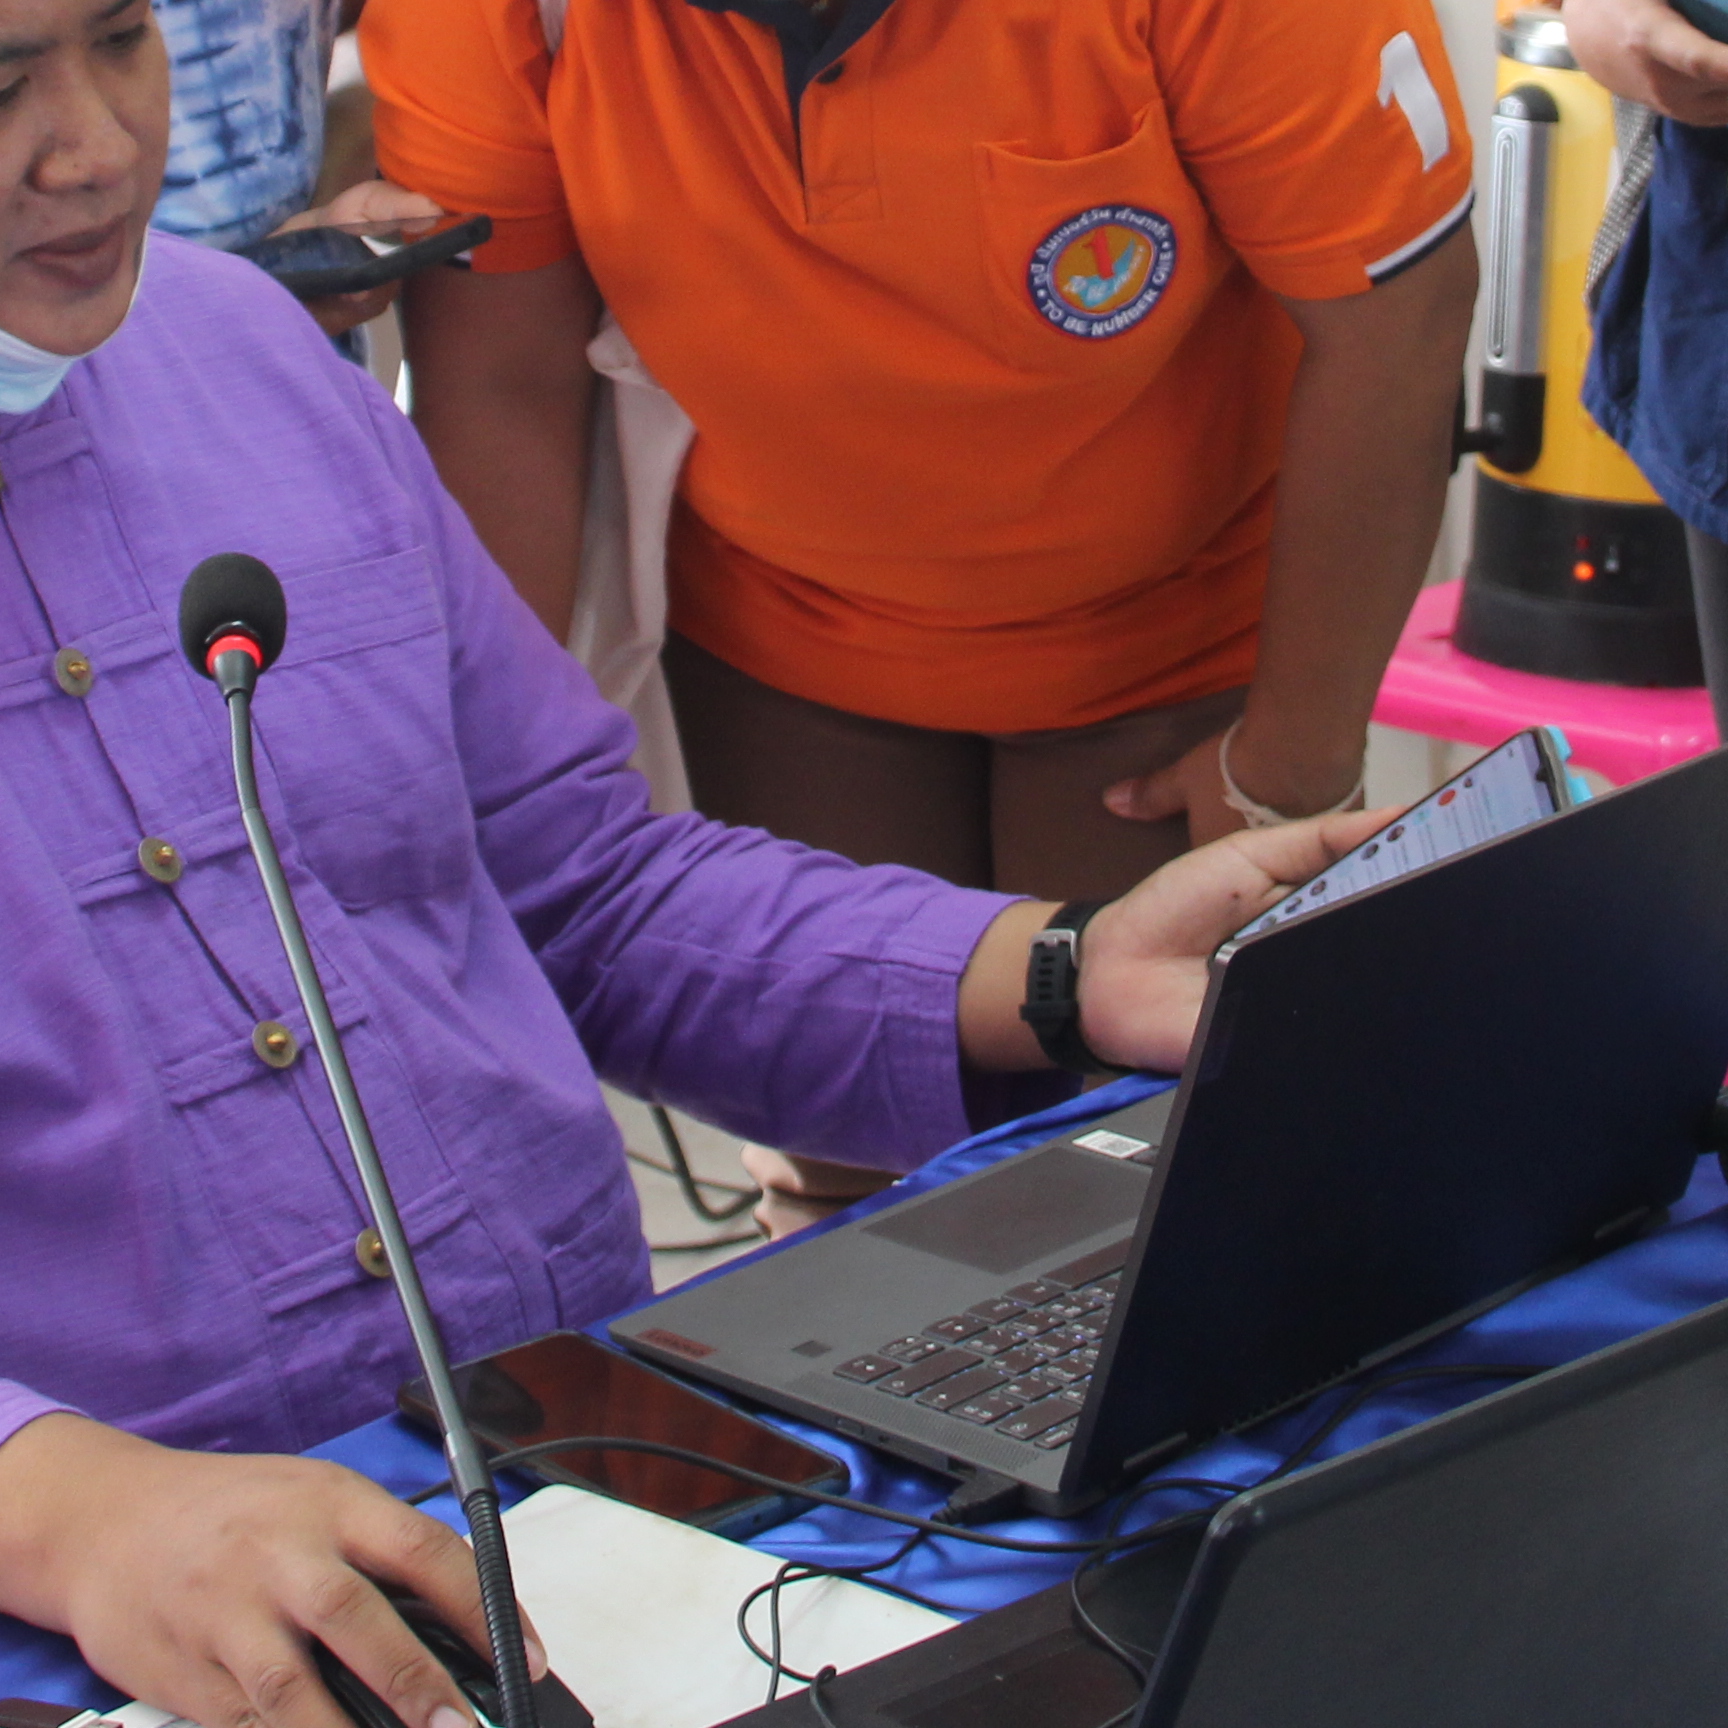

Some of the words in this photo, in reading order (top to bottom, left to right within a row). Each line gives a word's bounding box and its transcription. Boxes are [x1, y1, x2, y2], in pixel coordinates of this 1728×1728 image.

[1376, 30, 1450, 173] 1
[1041, 298, 1063, 321] TO
[1063, 316, 1089, 334] BE
[1091, 288, 1160, 337] NUMBER
[1151, 252, 1174, 286] ONE
